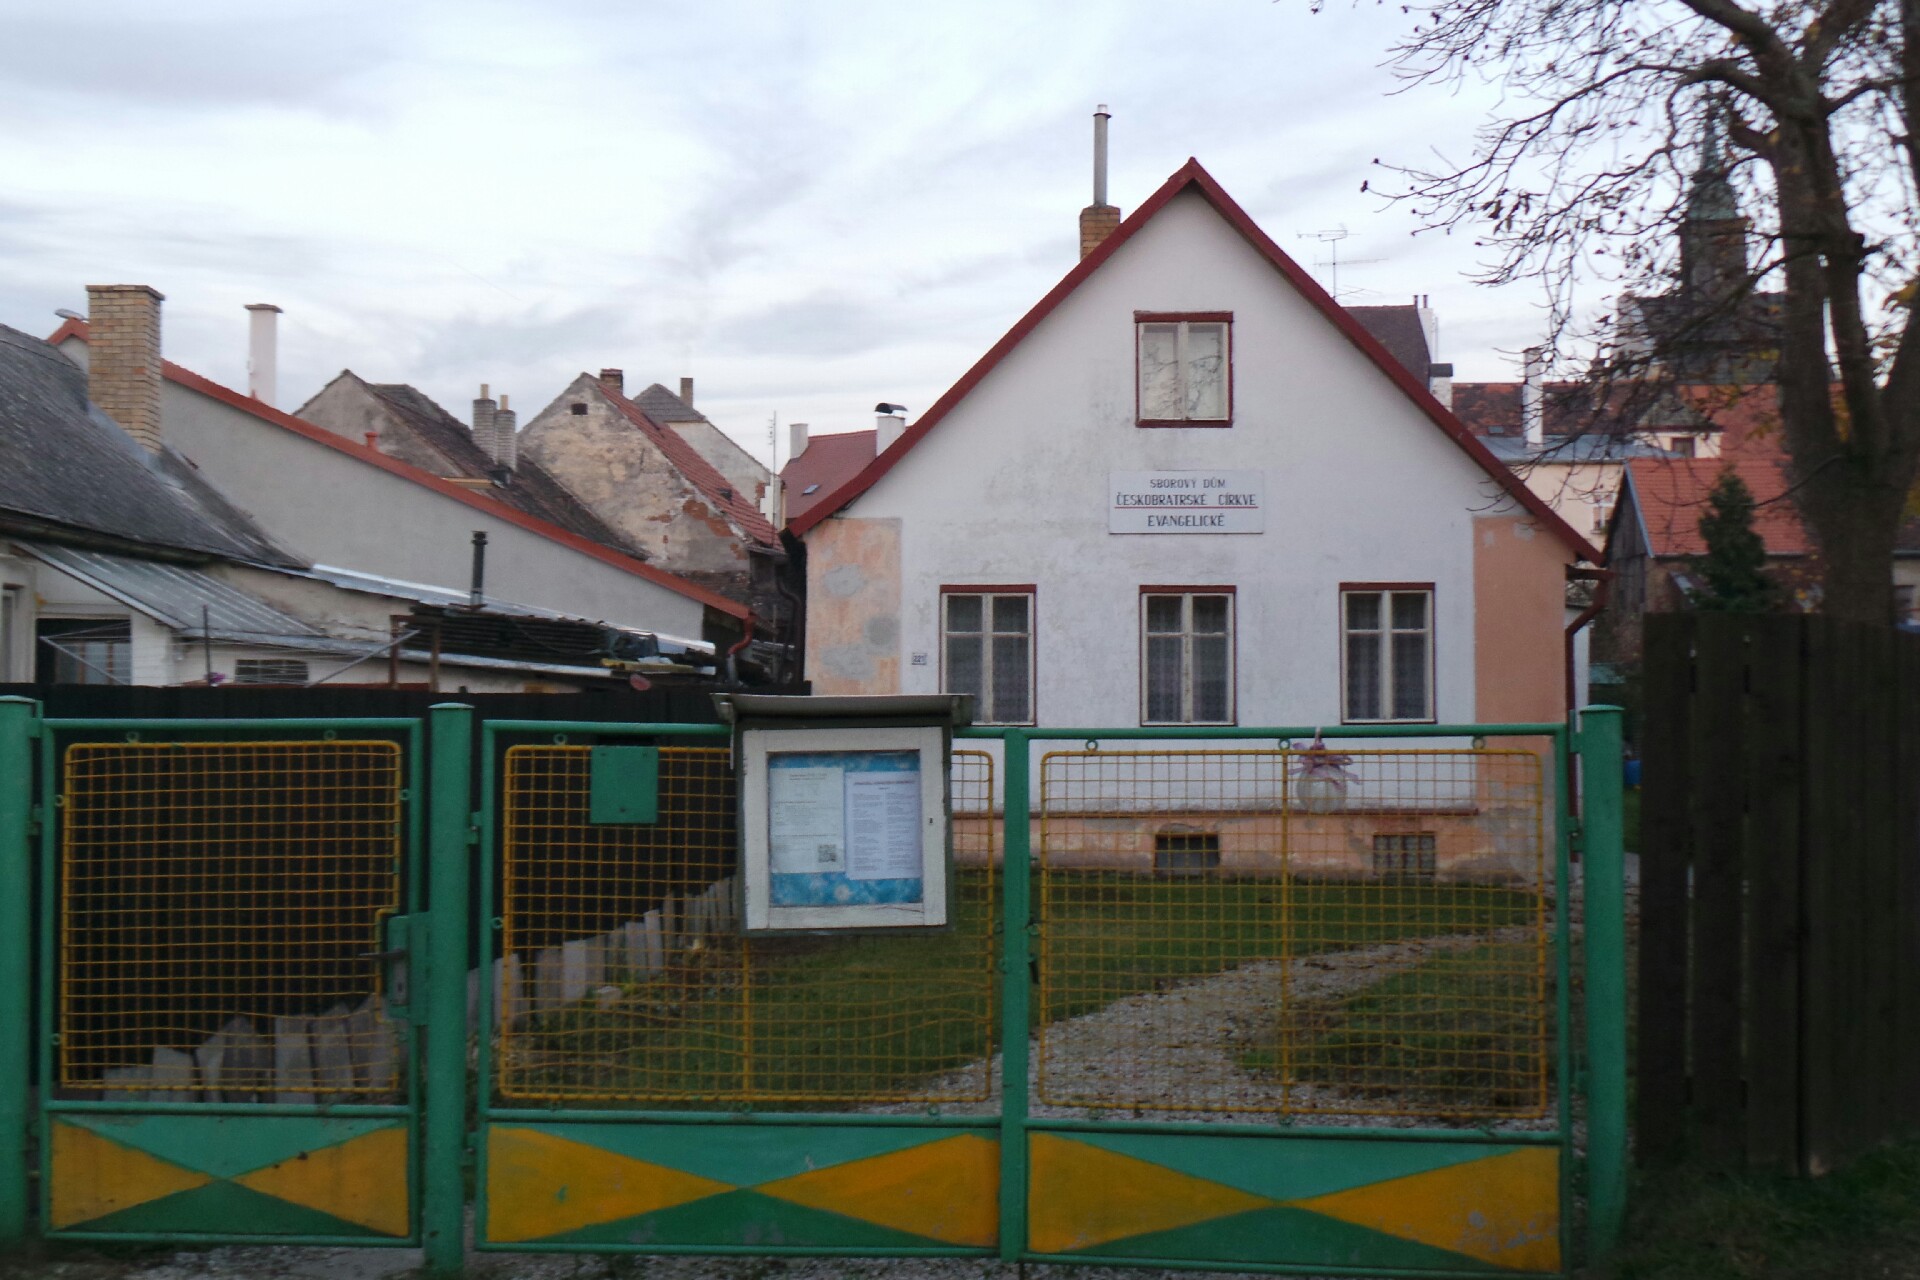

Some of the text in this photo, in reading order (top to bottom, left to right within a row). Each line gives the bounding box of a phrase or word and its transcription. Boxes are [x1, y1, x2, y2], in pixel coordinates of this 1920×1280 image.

[1116, 492, 1257, 505] ČESKOBRATRSKÉ CÍRKVE
[1147, 513, 1225, 527] EVANGELICKÉ
